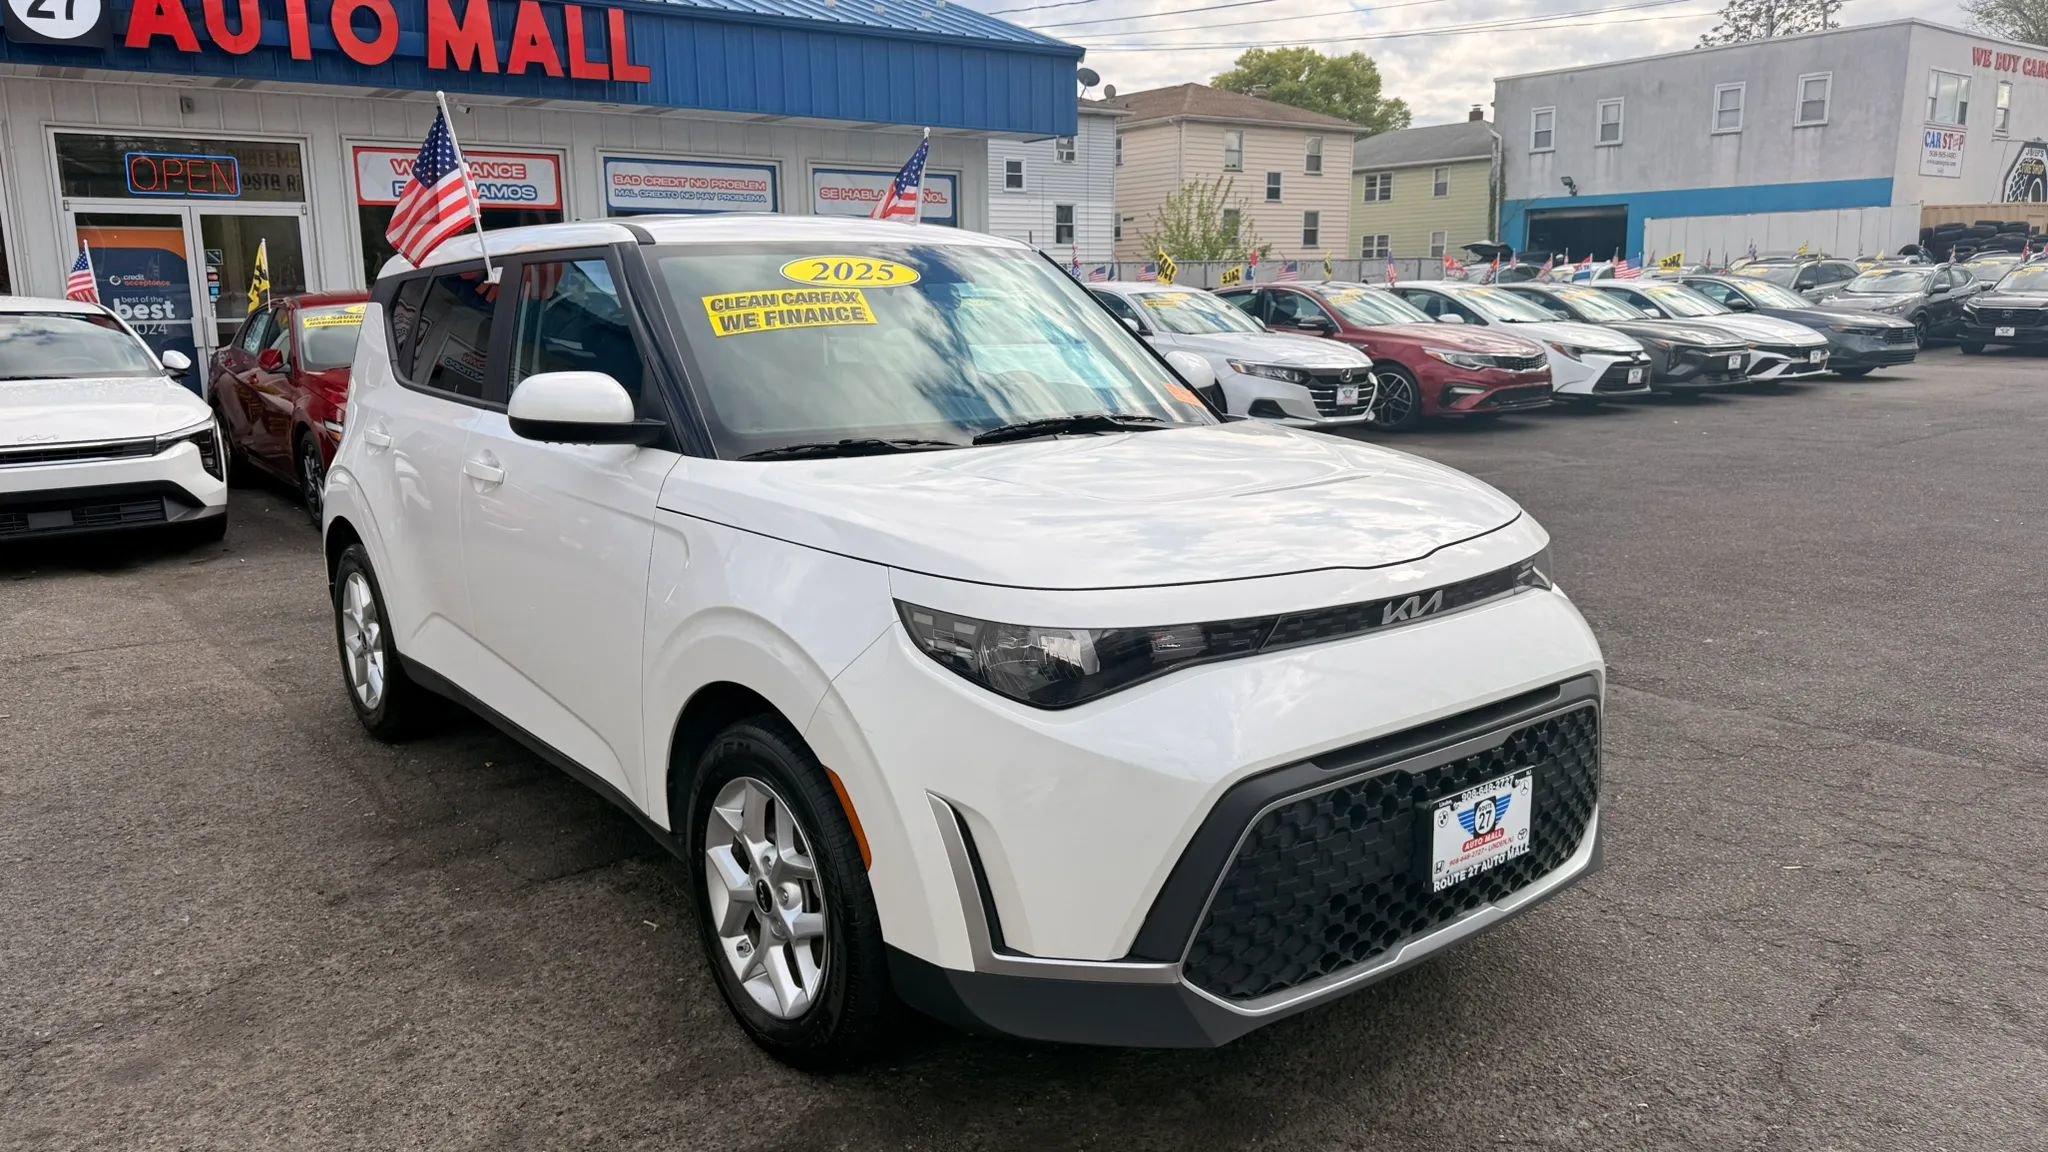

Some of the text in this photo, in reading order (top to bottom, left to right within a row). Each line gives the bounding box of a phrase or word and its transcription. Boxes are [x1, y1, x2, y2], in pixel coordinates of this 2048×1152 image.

[427, 0, 651, 83] MALL
[1972, 47, 1992, 68] WE
[1994, 52, 2021, 73] BUY
[1924, 131, 1941, 149] CAR
[131, 156, 237, 194] OPEN
[613, 174, 767, 192] BAD CREDIT NO PROBLEM
[615, 188, 767, 203] MAL CREDITO NO HAY PROBLEMA
[820, 187, 886, 201] SE HABLA
[811, 262, 894, 281] 2025
[113, 298, 175, 320] best
[710, 291, 858, 312] CLEAN CARFAX
[719, 306, 866, 332] WE FINANCE
[1382, 590, 1443, 625] KIA
[1478, 802, 1493, 813] ROUTE
[1478, 809, 1493, 831] 27
[1464, 829, 1502, 851] AUTO MALL
[1433, 843, 1530, 893] ROUTE 27 AUTO MALL
